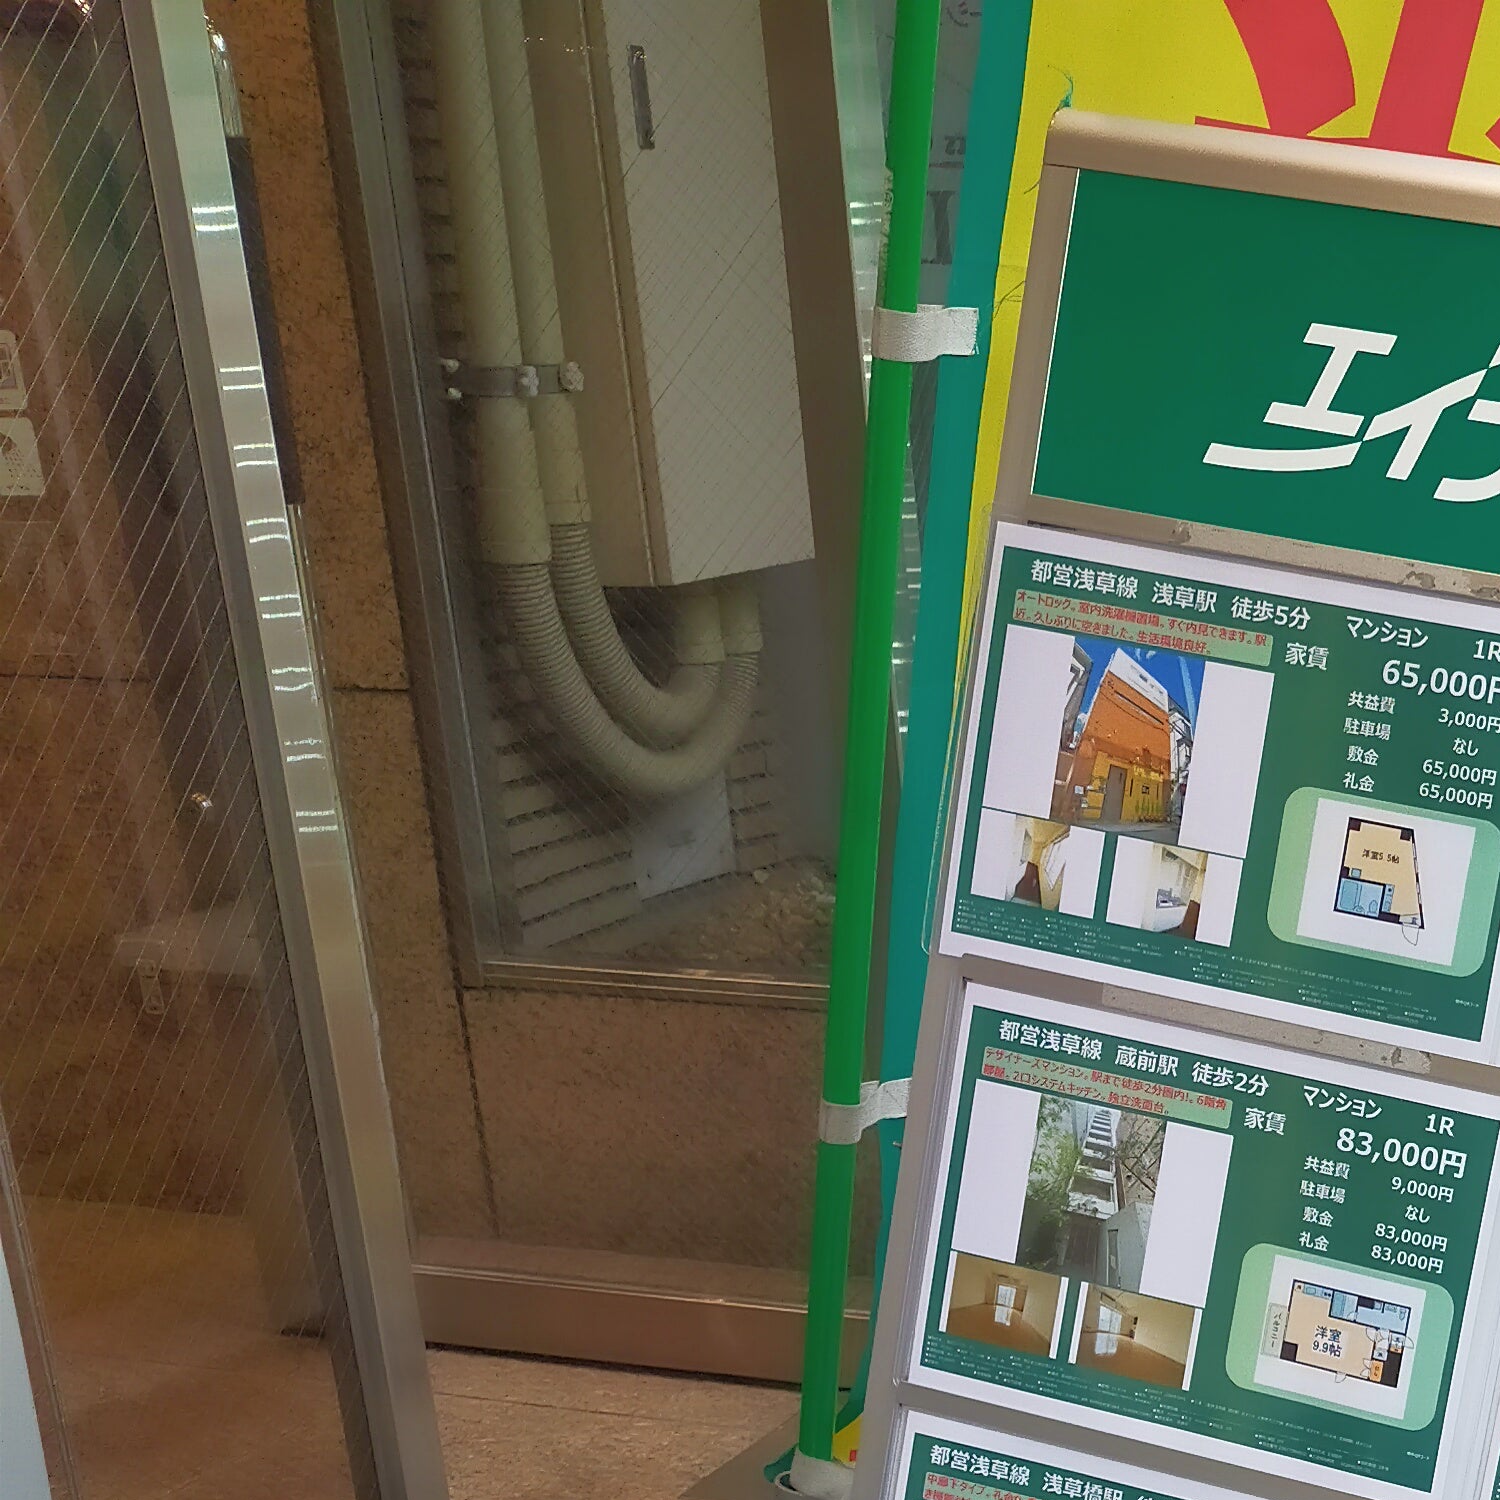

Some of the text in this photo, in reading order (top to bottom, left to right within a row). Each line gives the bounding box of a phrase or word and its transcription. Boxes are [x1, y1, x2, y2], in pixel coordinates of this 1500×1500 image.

[1030, 558, 1138, 599] 都営浅草線
[1150, 580, 1218, 613] 浅草駅
[1230, 594, 1311, 630] 徒歩5分
[1345, 614, 1429, 648] マンション
[1284, 641, 1329, 671] 家賃
[1346, 689, 1395, 714] 共益費
[1343, 716, 1479, 756] 駐車場 なし
[1345, 744, 1497, 786] 敷金 65,000円
[1342, 770, 1493, 810] 礼金 65,000円
[998, 1018, 1455, 1137] 都営浅草線 蔵前駅 徒歩2分 マンション 1R
[1242, 1106, 1467, 1179] 家賃 83,000円
[1302, 1154, 1454, 1203] 共益費 9,000円
[1301, 1205, 1448, 1252] 敷金 83,000円
[1298, 1230, 1444, 1274] 礼金 83,000円
[929, 1443, 1030, 1486] 都営浅草線
